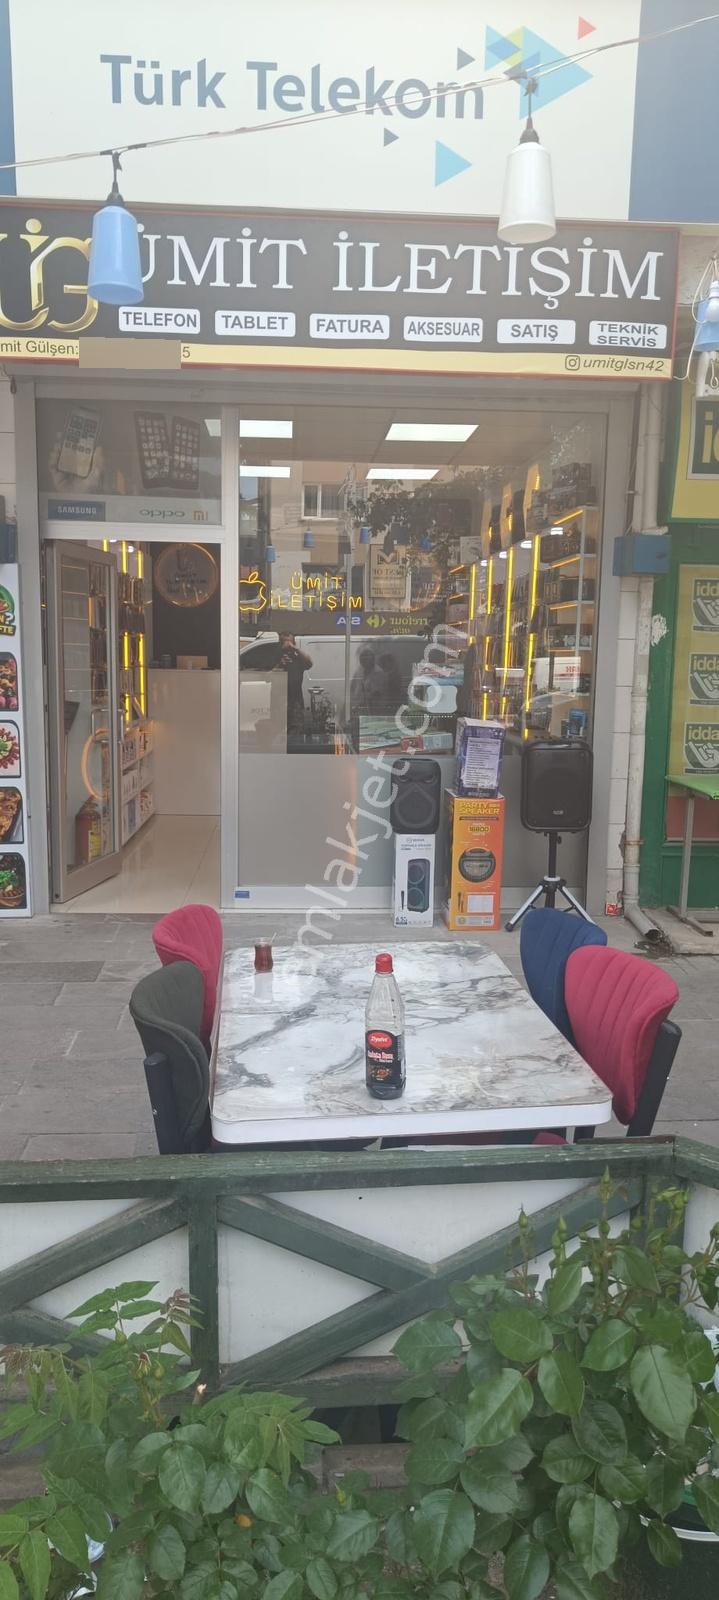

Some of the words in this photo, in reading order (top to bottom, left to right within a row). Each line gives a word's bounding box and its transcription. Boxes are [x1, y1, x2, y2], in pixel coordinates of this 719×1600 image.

[100, 54, 227, 109] Türk
[246, 61, 484, 120] Telekom
[332, 231, 664, 310] İLETİŞİM
[122, 311, 197, 328] TELEFON
[221, 315, 288, 331] TABLET
[316, 319, 384, 334] FATURA
[407, 321, 480, 336] AKSESUAR
[510, 324, 559, 342] SATIŞ
[598, 322, 658, 336] TEKNİK
[25, 340, 79, 357] Gülşen:
[597, 334, 657, 348] SERVİS
[583, 356, 664, 372] umitglsn42
[57, 505, 97, 515] SAMSUNG
[290, 571, 343, 590] ÜMİT
[270, 590, 363, 611] İLETİŞİM
